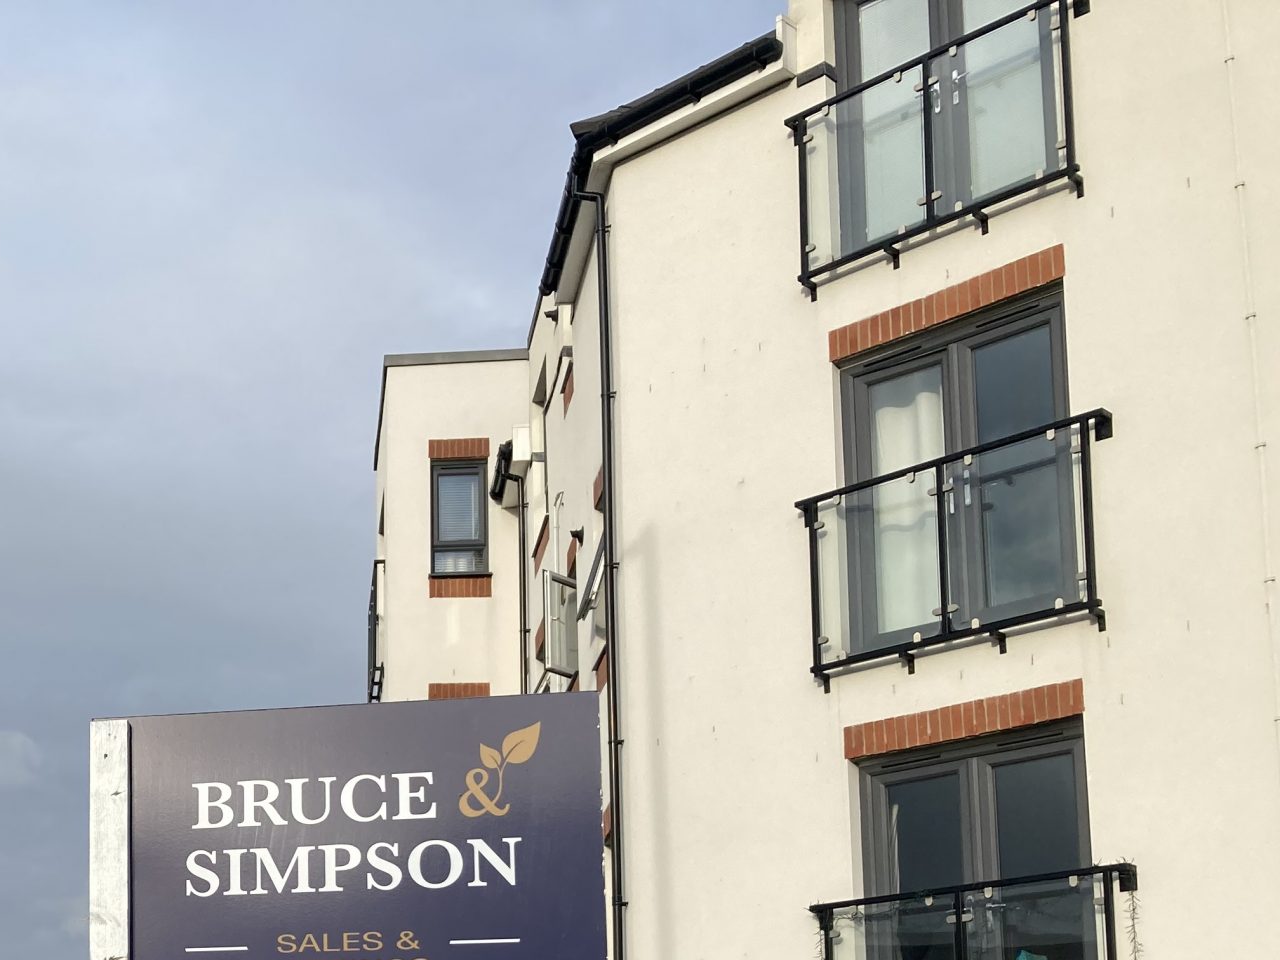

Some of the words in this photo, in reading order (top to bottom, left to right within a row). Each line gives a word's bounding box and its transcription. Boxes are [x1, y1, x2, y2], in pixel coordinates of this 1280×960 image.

[191, 771, 437, 829] BRUCE
[458, 767, 510, 818] &
[185, 837, 522, 897] SIMPSON
[277, 932, 383, 954] SALES
[396, 931, 420, 951] &
